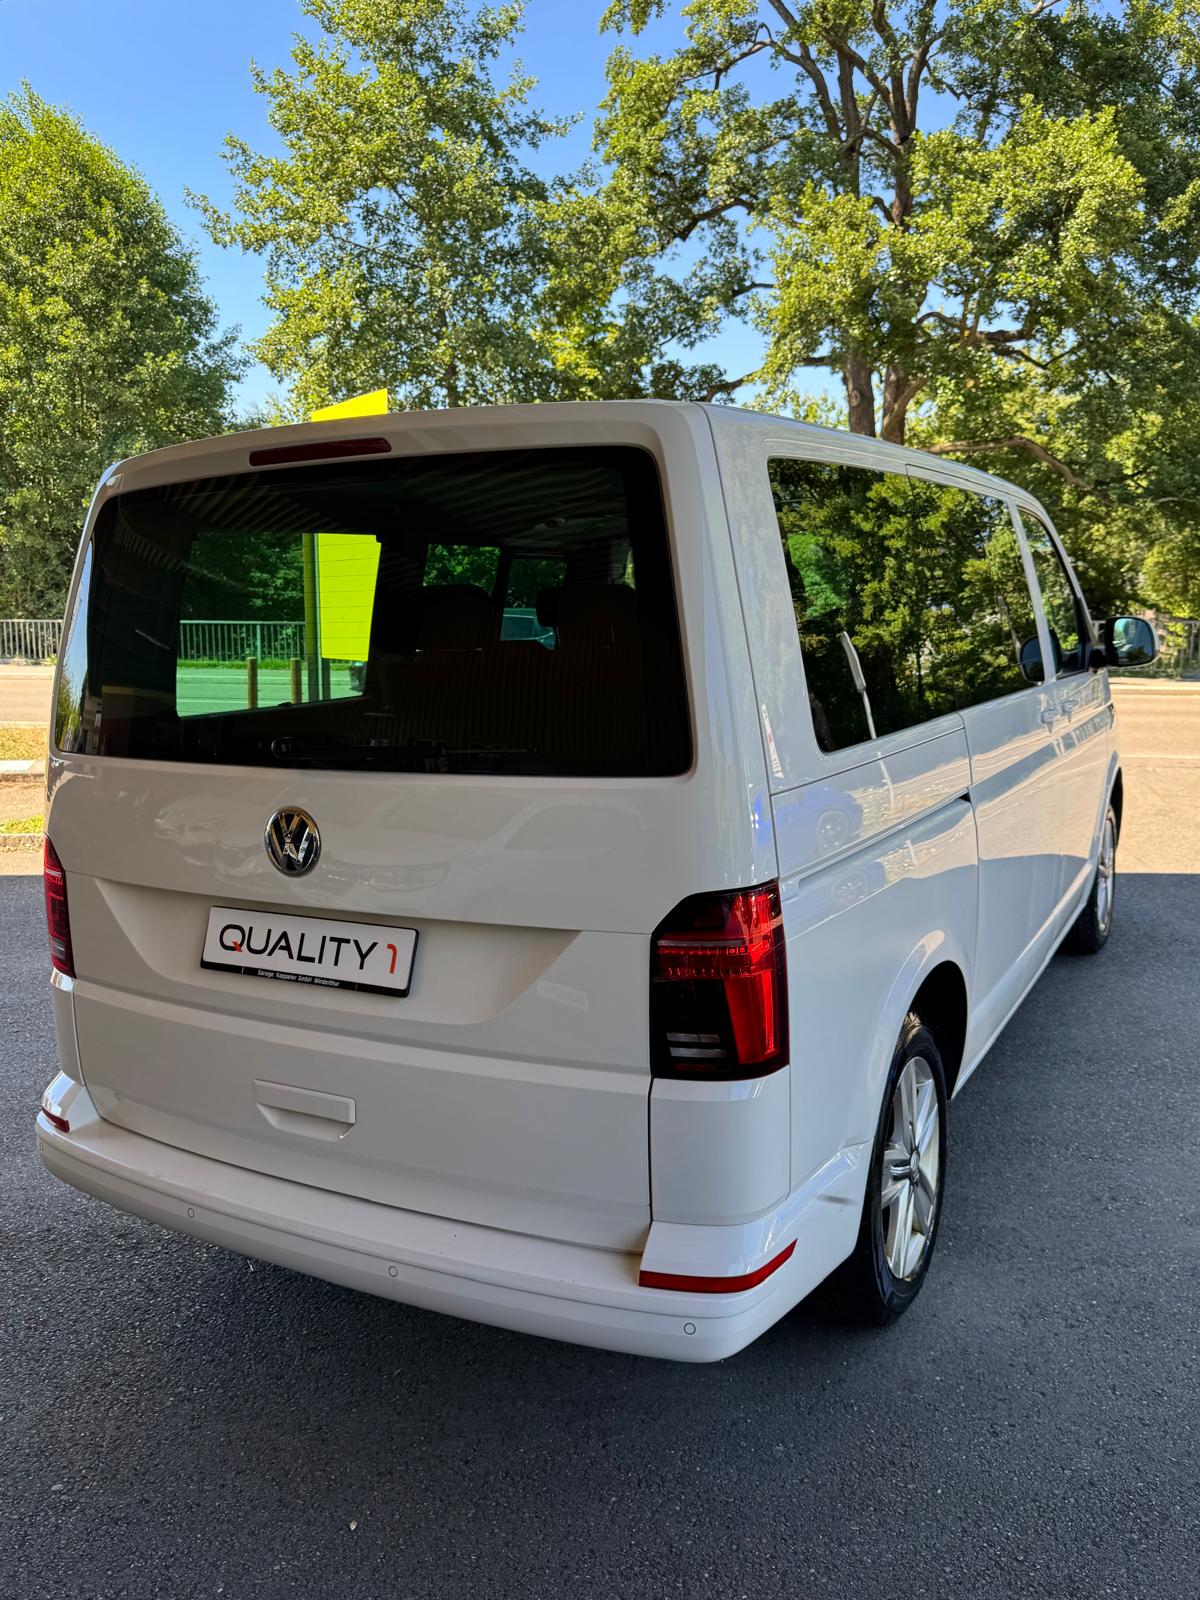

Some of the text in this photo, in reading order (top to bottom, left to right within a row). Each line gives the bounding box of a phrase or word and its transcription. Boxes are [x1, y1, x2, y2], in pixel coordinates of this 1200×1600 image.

[268, 810, 319, 873] VW
[219, 924, 397, 974] QUALITY 1
[257, 969, 274, 977] Garage
[298, 975, 313, 983] GmbH
[314, 978, 340, 986] Winterthur
